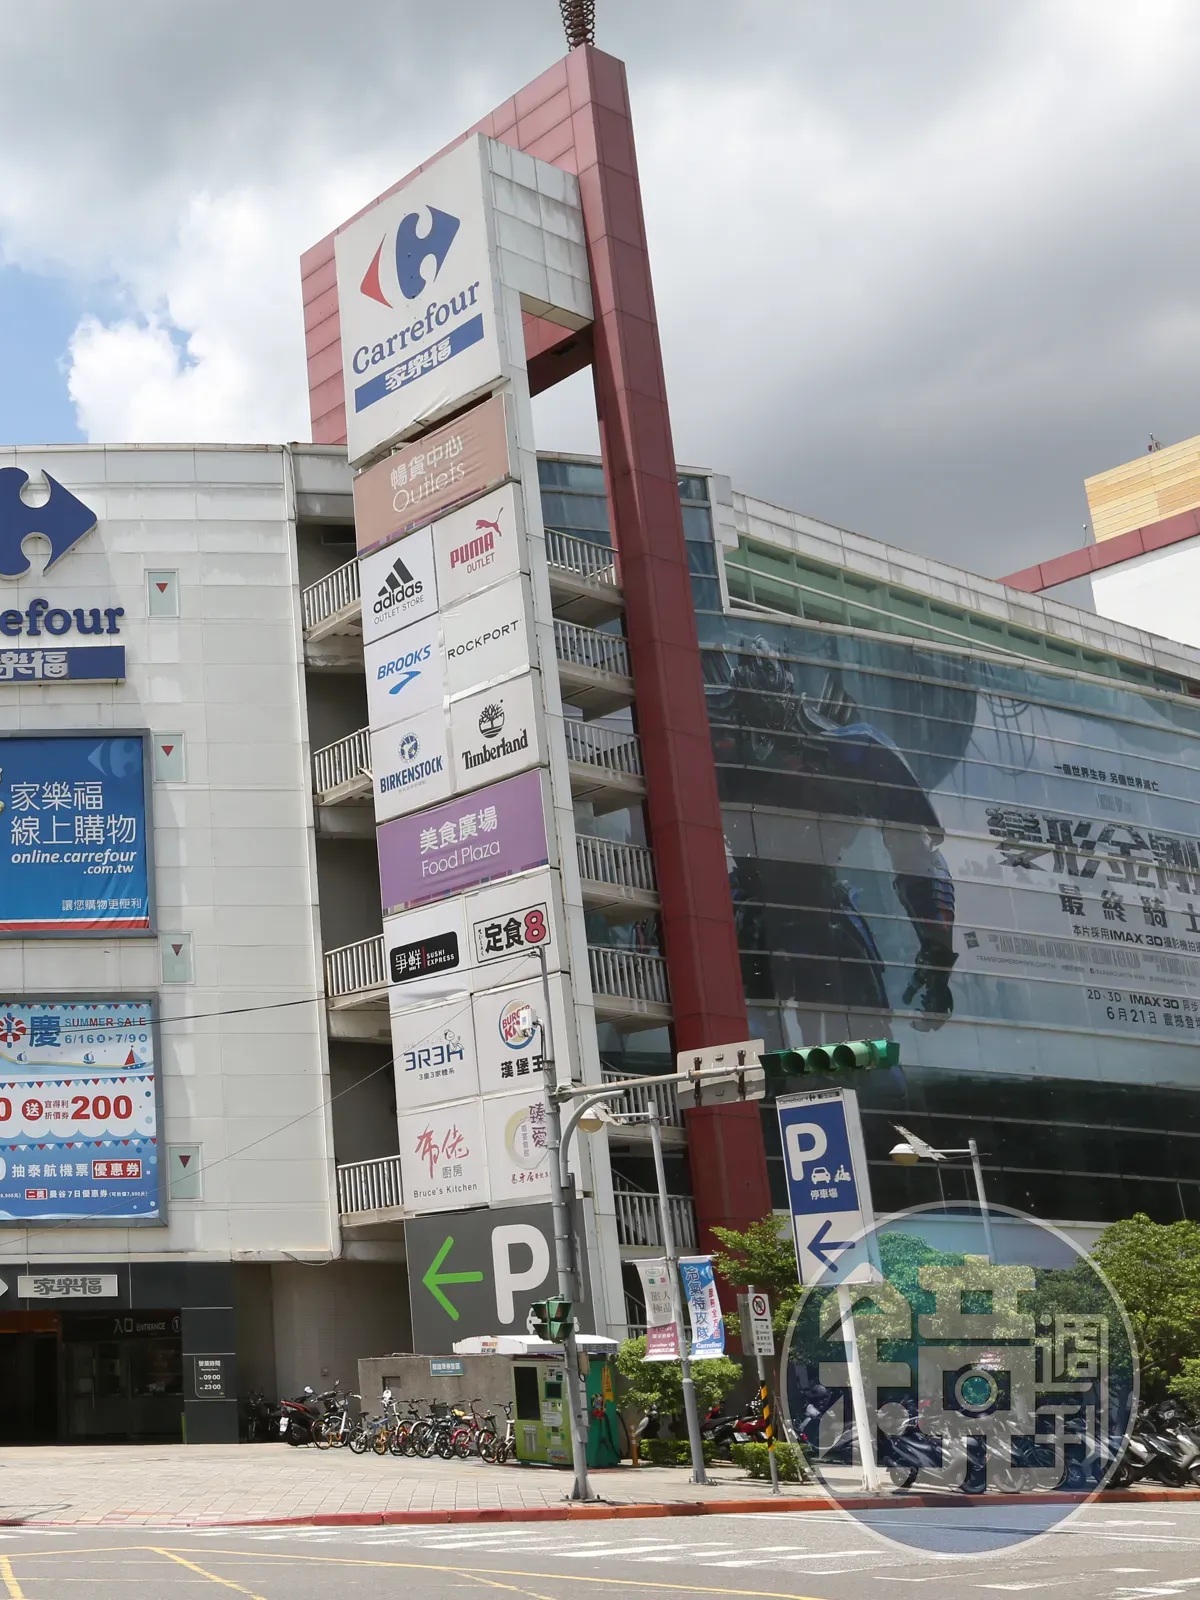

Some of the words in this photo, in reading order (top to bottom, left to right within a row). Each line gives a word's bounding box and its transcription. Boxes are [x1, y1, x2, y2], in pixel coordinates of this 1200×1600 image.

[353, 281, 479, 374] Carrefour
[385, 336, 451, 391] 家樂福
[391, 435, 463, 490] 暢貨中心
[393, 461, 465, 513] Outlets
[450, 531, 494, 569] PUMA
[467, 552, 495, 574] OUTLET
[373, 579, 423, 613] adidas
[374, 606, 400, 624] OUTLET
[402, 595, 425, 612] STORE
[448, 620, 519, 660] ROCKPORT
[377, 644, 431, 680] BROOKS
[462, 729, 528, 770] Timberland
[380, 755, 443, 793] BIRKENSTOCK
[10, 781, 103, 812] 家樂福
[10, 814, 136, 846] 線上購物
[420, 805, 498, 855] 美食廣場
[11, 849, 136, 865] online.carrefour
[83, 864, 134, 875] .com.tw
[422, 850, 458, 878] Food
[462, 839, 500, 865] Plaza
[426, 949, 445, 960] SUSHI
[427, 954, 455, 967] EXPRESS
[1130, 994, 1161, 1007] IMAX
[65, 1017, 114, 1027] SUMMER
[117, 1016, 146, 1026] SALE
[502, 1005, 530, 1029] BURG
[1106, 1007, 1157, 1024] 6月21日
[501, 1055, 543, 1078] 漢堡王
[26, 1102, 40, 1117] 送
[71, 1095, 133, 1120] 200
[785, 1122, 827, 1182] P
[94, 1163, 140, 1177] 優惠券
[413, 1186, 443, 1198] Bruce's
[446, 1182, 478, 1194] Kitchen
[810, 1187, 838, 1200] 停車場
[33, 1277, 103, 1295] 家樂福
[491, 1223, 550, 1325] P
[114, 1318, 133, 1334] 入口
[136, 1322, 166, 1332] ENTRANCE
